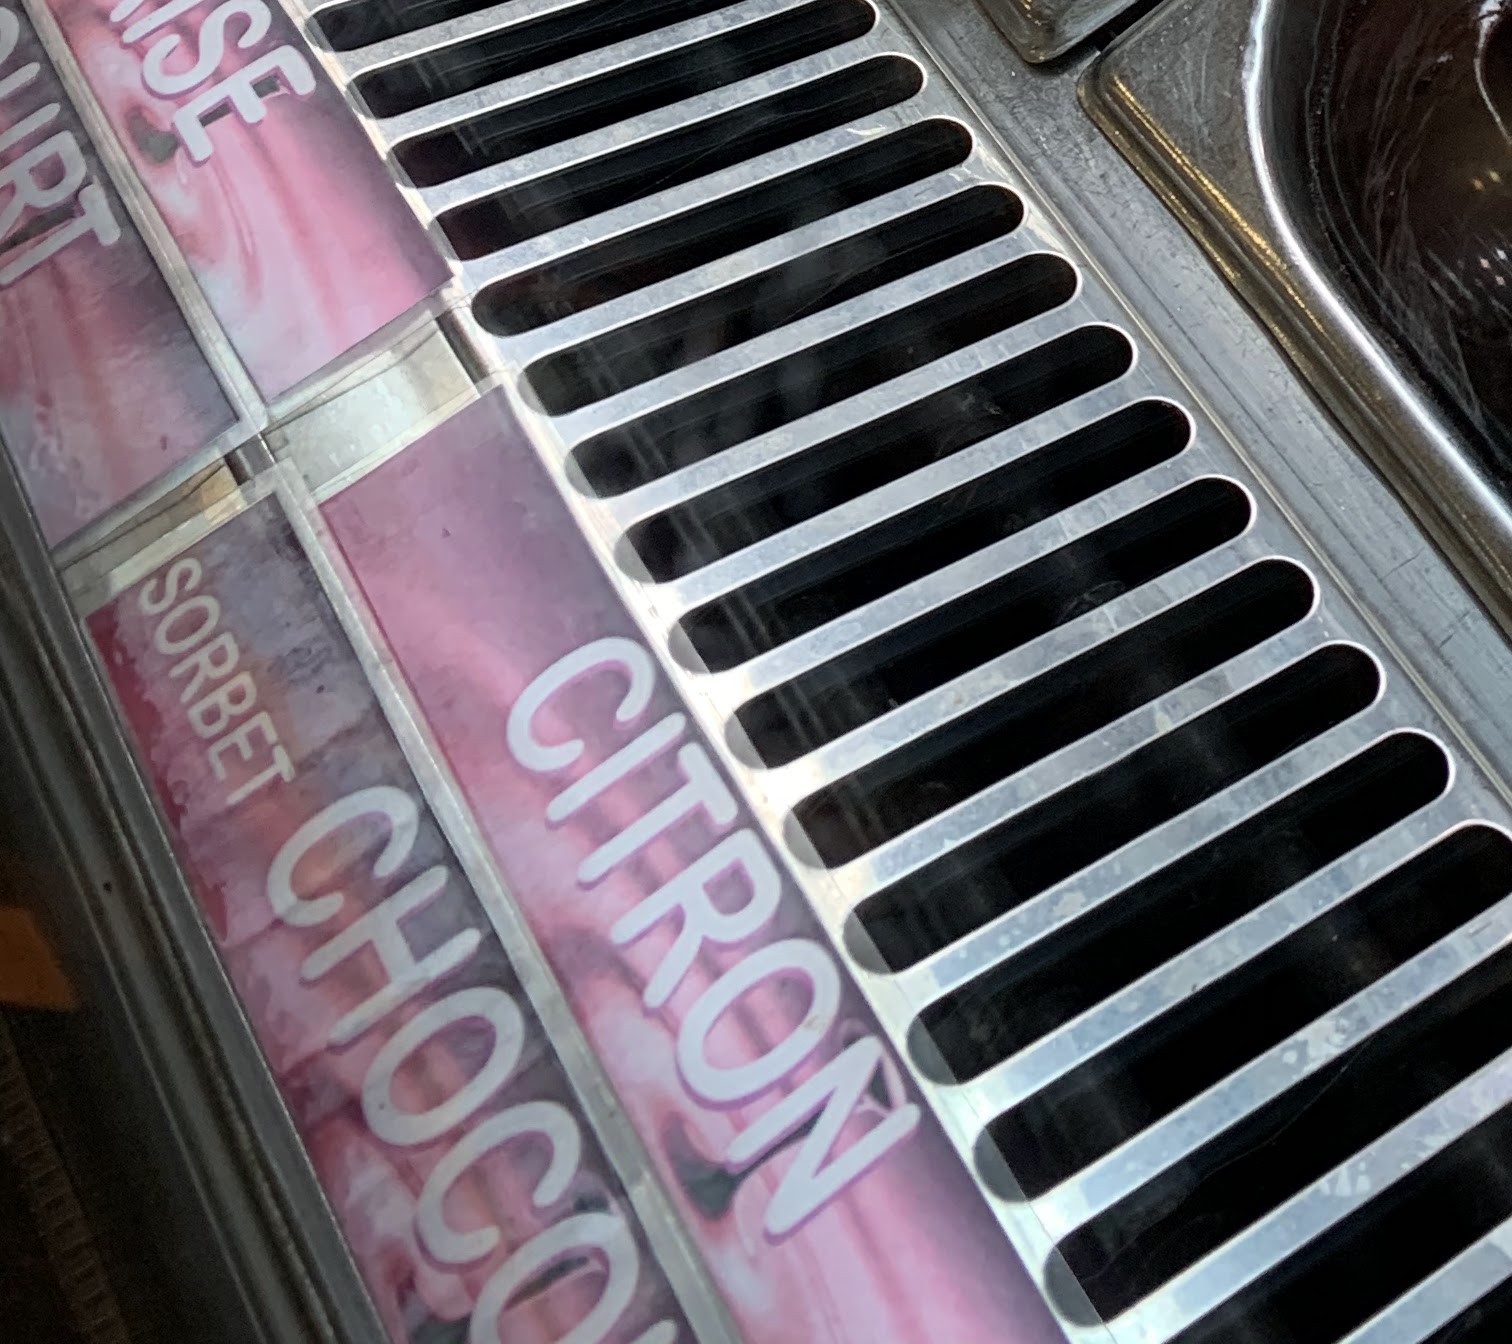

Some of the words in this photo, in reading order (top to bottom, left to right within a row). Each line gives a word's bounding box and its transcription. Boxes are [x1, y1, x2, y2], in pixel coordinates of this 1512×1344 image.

[138, 557, 295, 805] SORBET
[266, 785, 677, 1344] CHOCO
[506, 636, 921, 1236] CITRON
